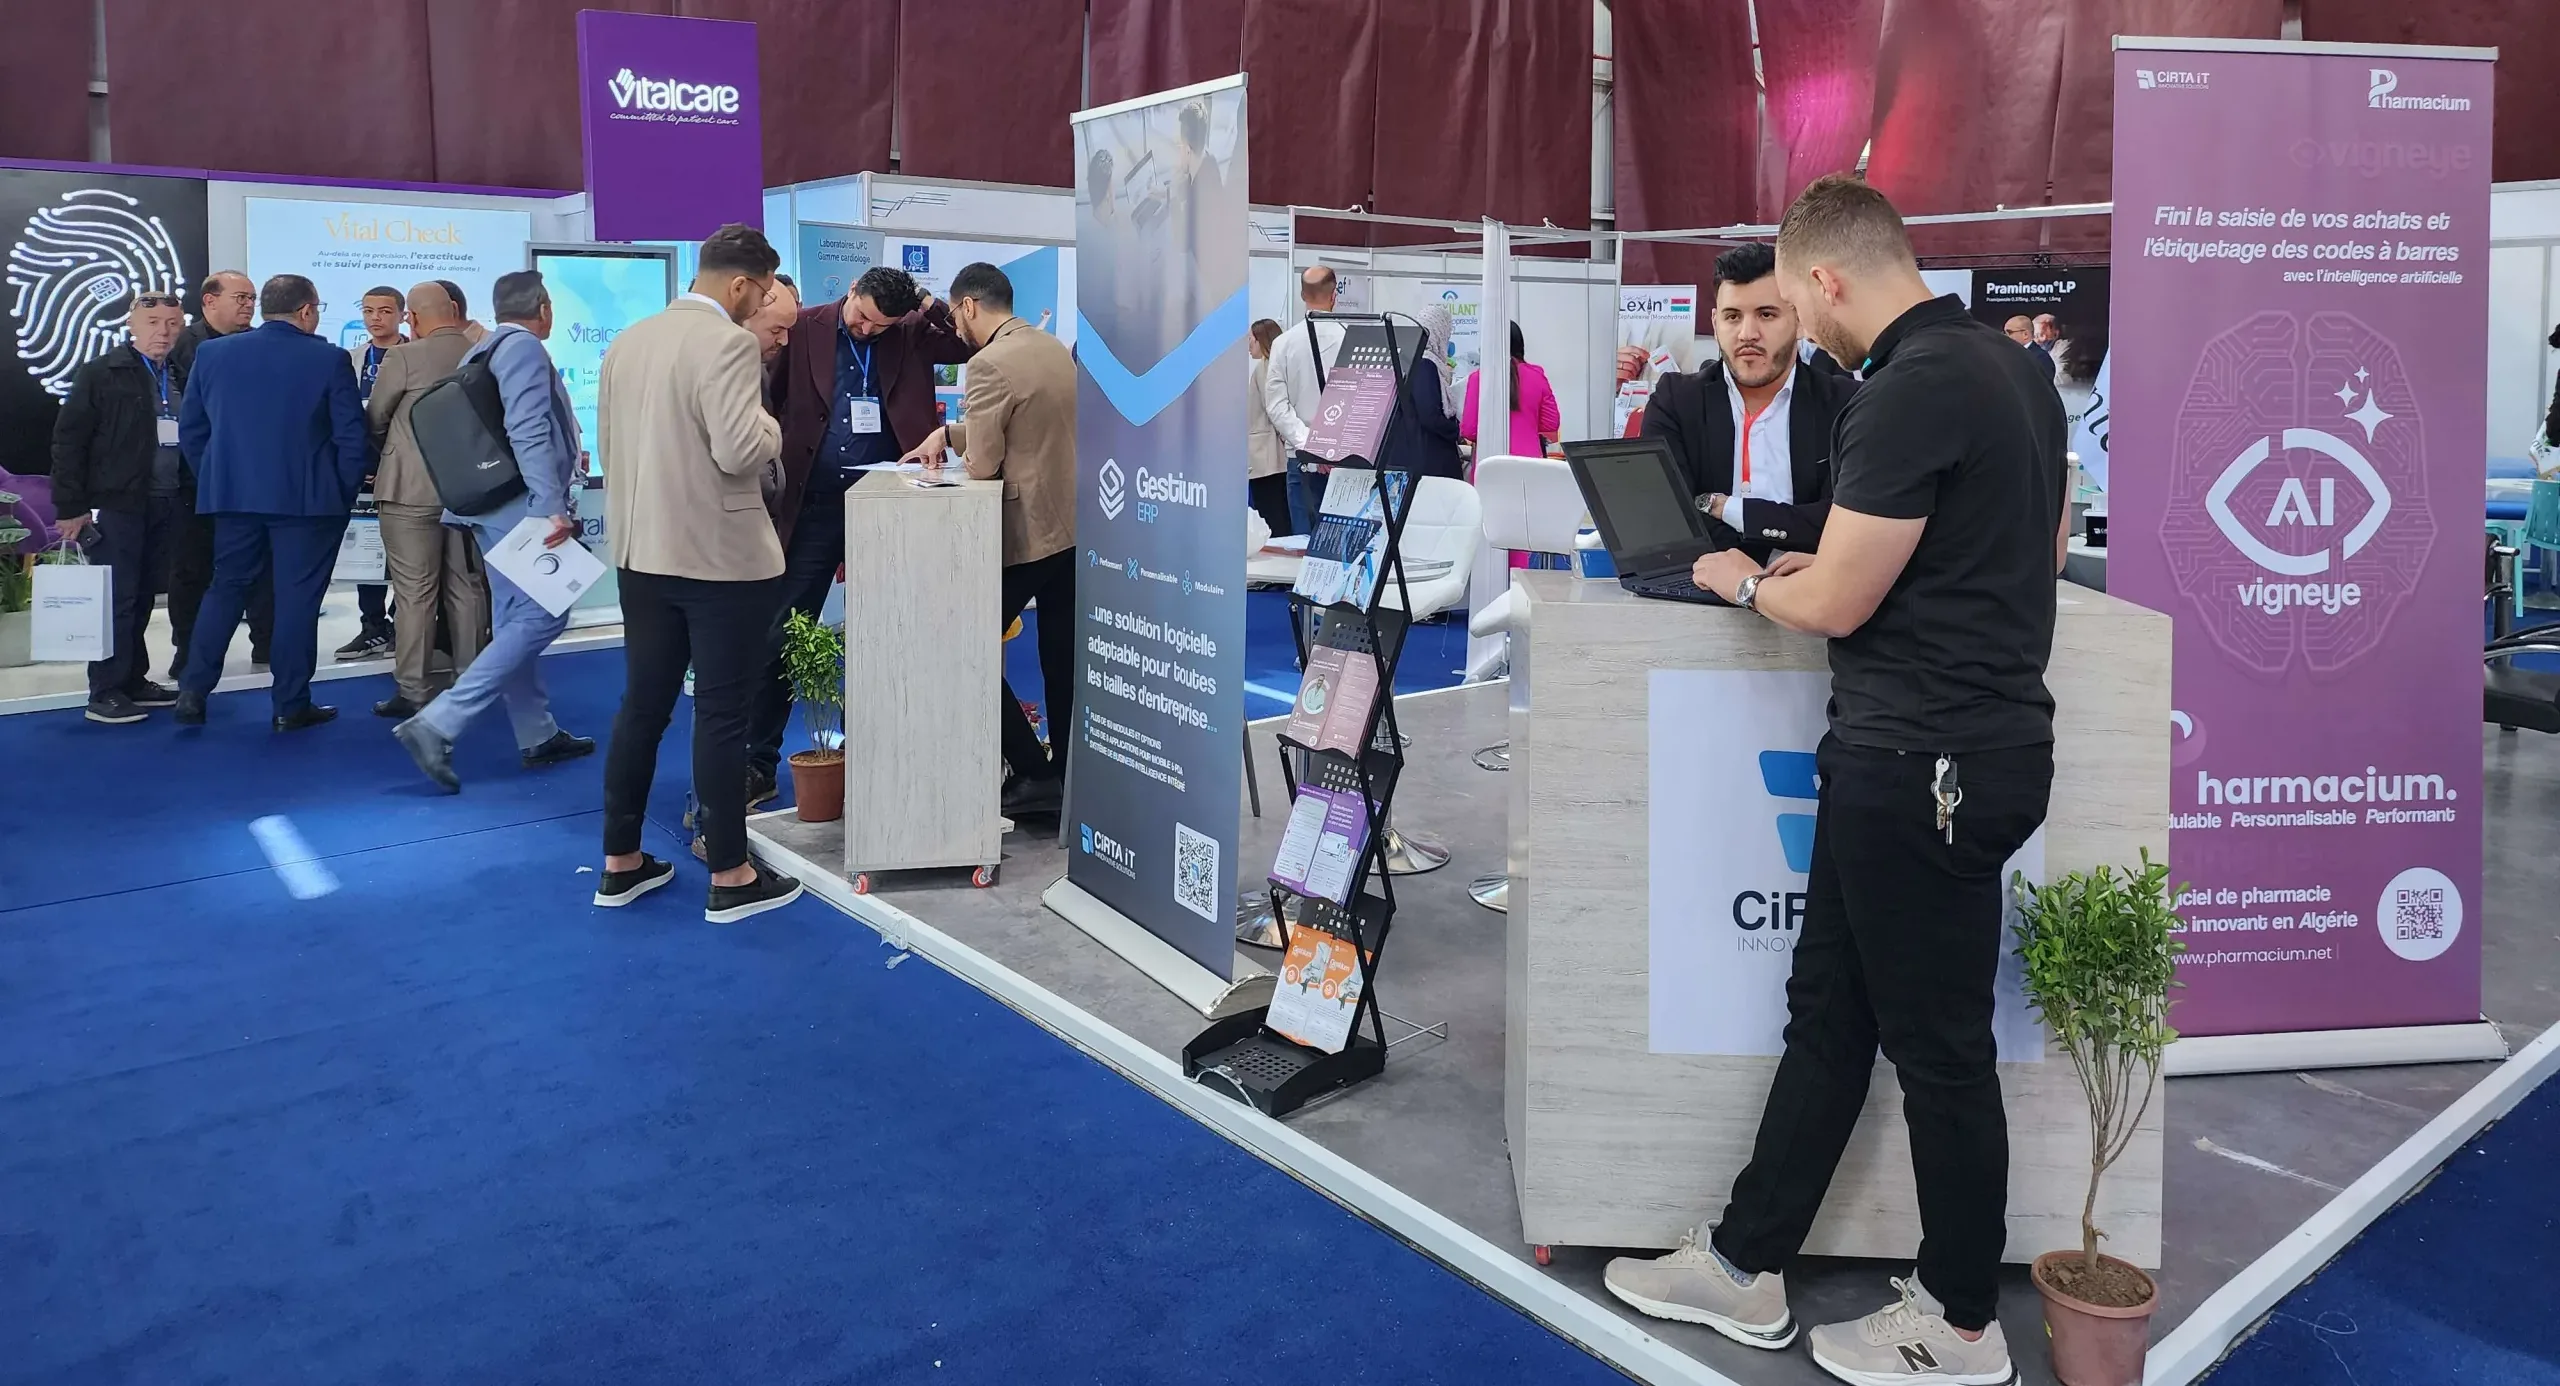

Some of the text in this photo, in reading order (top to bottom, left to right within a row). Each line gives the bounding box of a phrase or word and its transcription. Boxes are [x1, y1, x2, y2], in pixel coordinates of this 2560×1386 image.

[608, 67, 739, 112] Vitalcare
[2368, 69, 2471, 110] Pharmacium
[324, 212, 464, 245] Vital Check
[2154, 206, 2450, 230] Fini la saisie de vos achats et
[411, 251, 475, 261] l'exactitude
[819, 238, 868, 250] Laboratoires UPC
[2143, 237, 2459, 263] l'étiquetage des codes à barres
[334, 260, 361, 269] suivi
[364, 261, 434, 272] personnalisé
[817, 252, 871, 266] Gamme cardiologie
[903, 265, 929, 273] UPC
[2283, 269, 2463, 286] avec l'intelligence artificielle
[1136, 466, 1208, 508] Gestium
[1137, 502, 1159, 523] ERP
[2264, 478, 2334, 526] AI
[1194, 581, 1224, 595] Modulaire
[2238, 577, 2362, 615] vigneye
[1115, 612, 1161, 641] solution
[1164, 622, 1217, 658] logicielle
[1088, 635, 1217, 695] adaptable pour toutes
[1087, 664, 1102, 687] les
[1103, 671, 1136, 701] tailles
[2169, 807, 2455, 829] dulable Personnalisable Performant
[1094, 830, 1123, 863] CiRTA
[2215, 887, 2238, 904] de
[2241, 884, 2331, 909] pharmacie
[2191, 912, 2268, 932] innovant
[2272, 915, 2293, 929] en
[2298, 911, 2358, 933] Algérie
[2170, 946, 2332, 967] www.pharmacium.net
